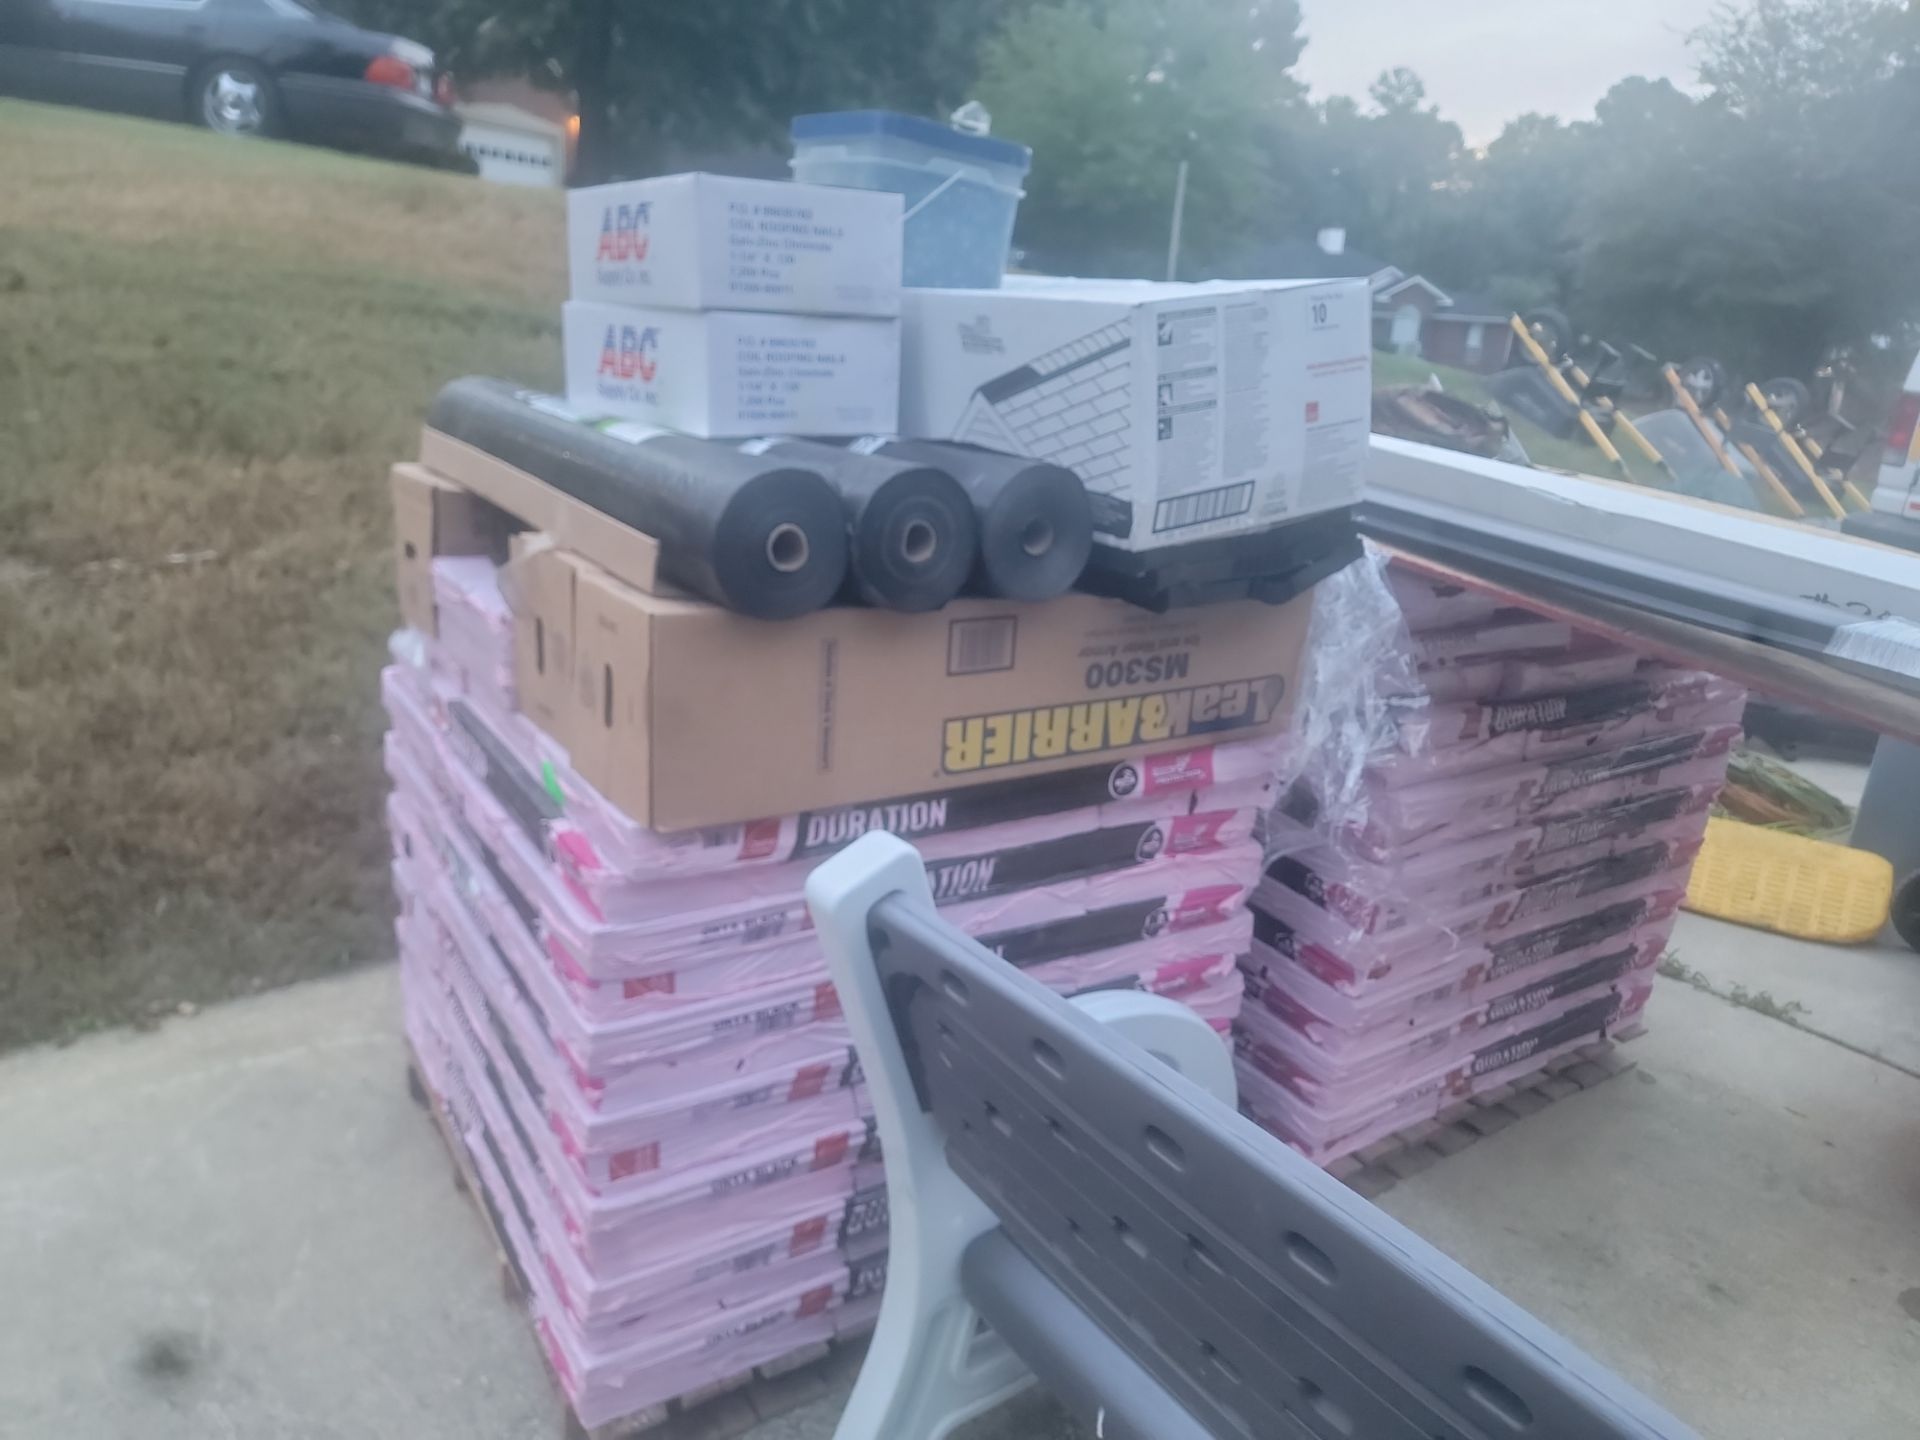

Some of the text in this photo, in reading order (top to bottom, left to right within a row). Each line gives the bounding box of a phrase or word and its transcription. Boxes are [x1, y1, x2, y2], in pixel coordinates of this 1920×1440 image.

[596, 201, 654, 263] ABC
[1312, 303, 1327, 323] 10
[596, 323, 661, 383] ABC
[1084, 652, 1190, 690] MS300
[805, 799, 948, 847] DURATION
